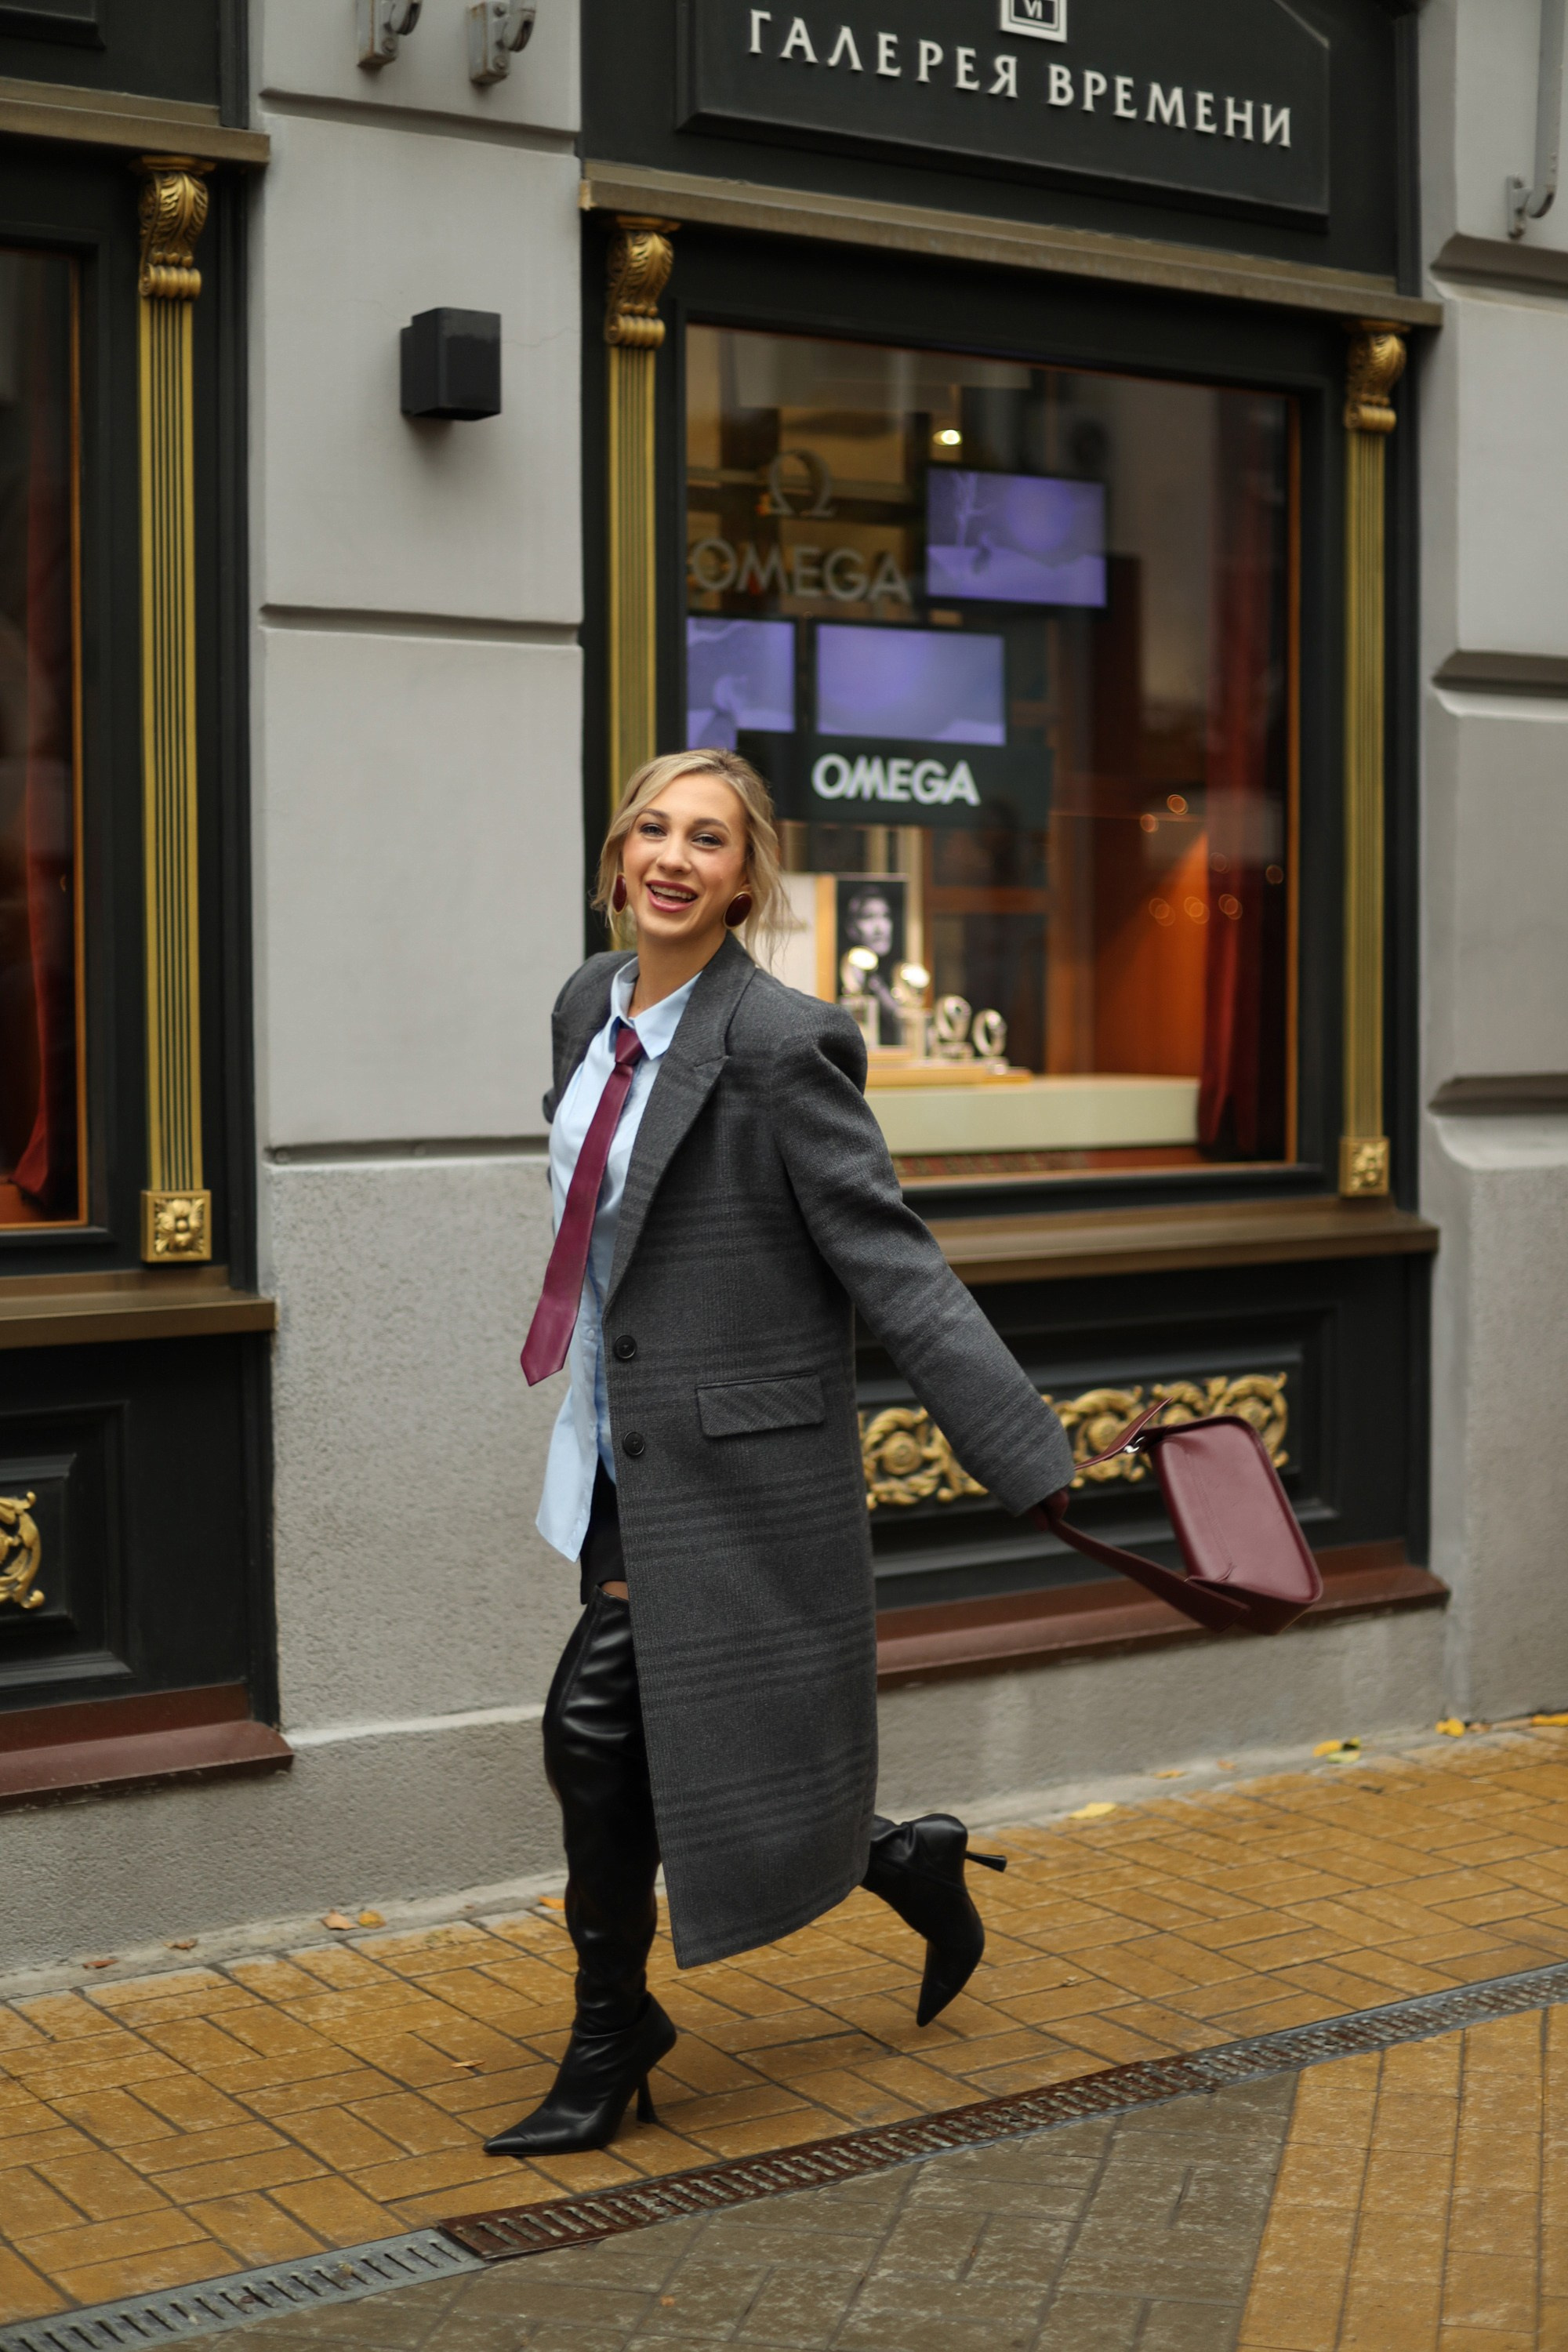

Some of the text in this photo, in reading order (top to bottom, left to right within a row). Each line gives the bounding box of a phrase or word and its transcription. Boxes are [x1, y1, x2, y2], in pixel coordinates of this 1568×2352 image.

[749, 8, 1292, 148] ГАЛЕРЕЯ ВРЕМЕНИ
[690, 538, 912, 603] OMEGA
[811, 753, 981, 806] OMEGA
